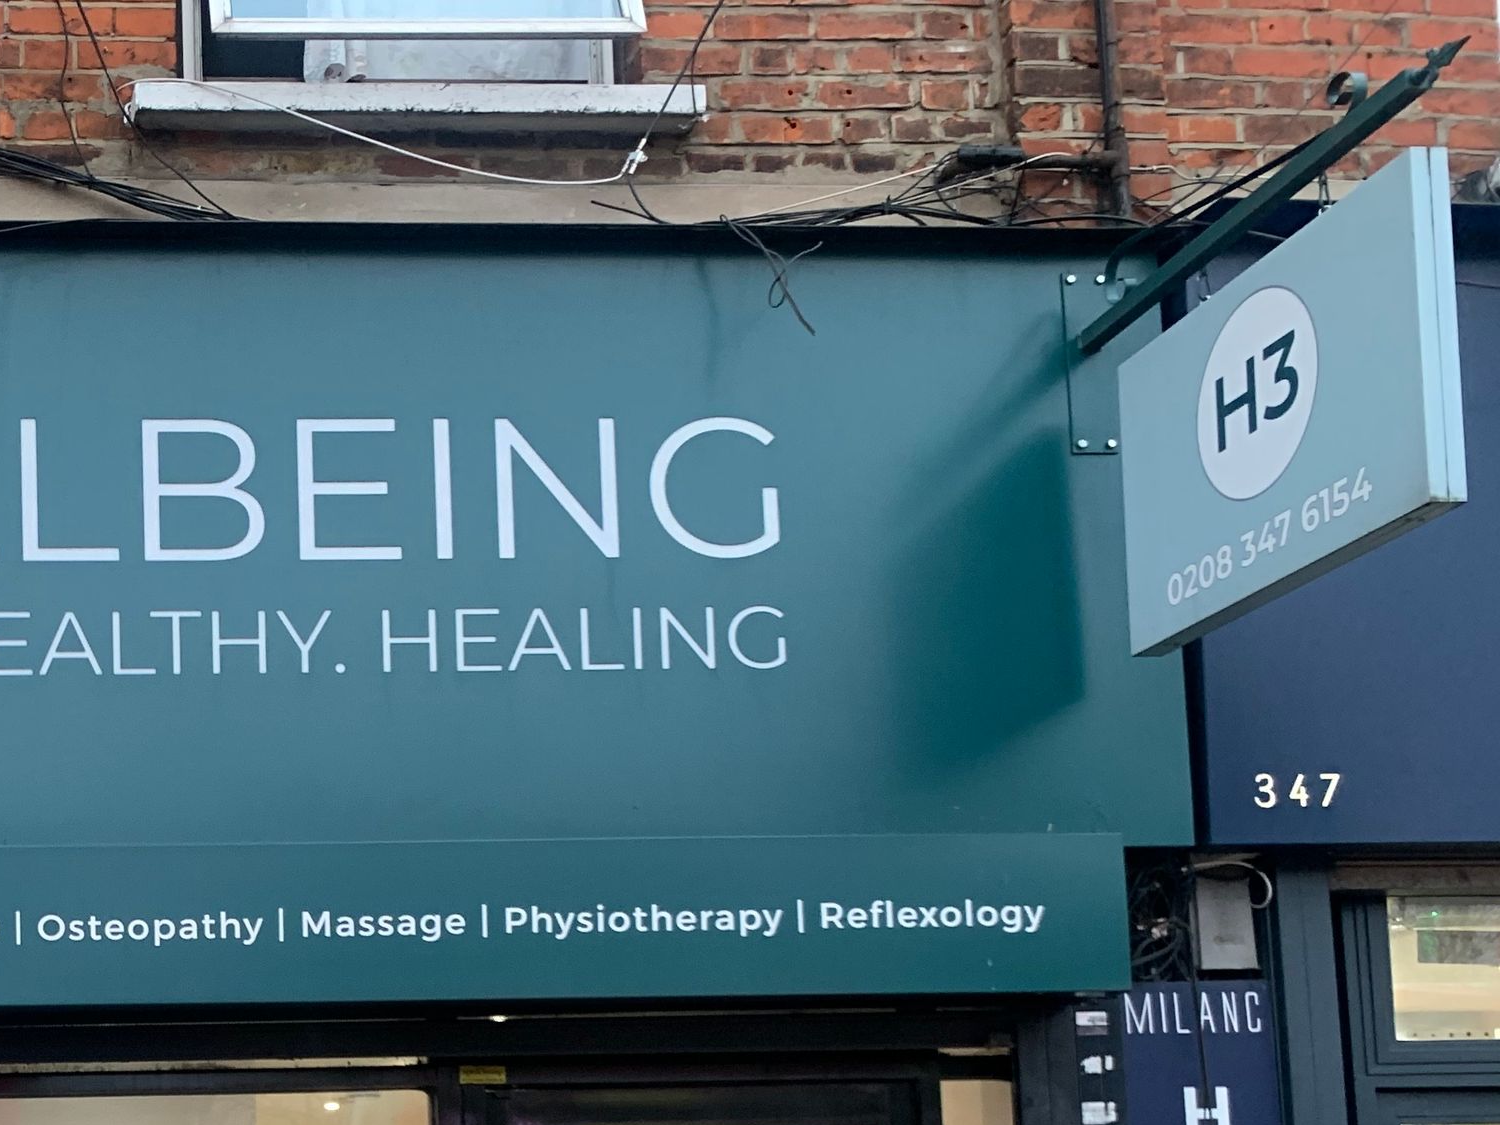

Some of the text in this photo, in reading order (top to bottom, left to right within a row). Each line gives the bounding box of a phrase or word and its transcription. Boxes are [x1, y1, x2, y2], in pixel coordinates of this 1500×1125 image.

[1214, 329, 1299, 454] H3
[1166, 466, 1373, 607] 0208 347 6154
[381, 604, 787, 673] HEALING
[1253, 773, 1341, 809] 347
[37, 910, 264, 947] Osteopathy
[301, 910, 466, 942] Massage
[504, 903, 784, 940] Physiotherapy
[820, 898, 1045, 934] Reflexology
